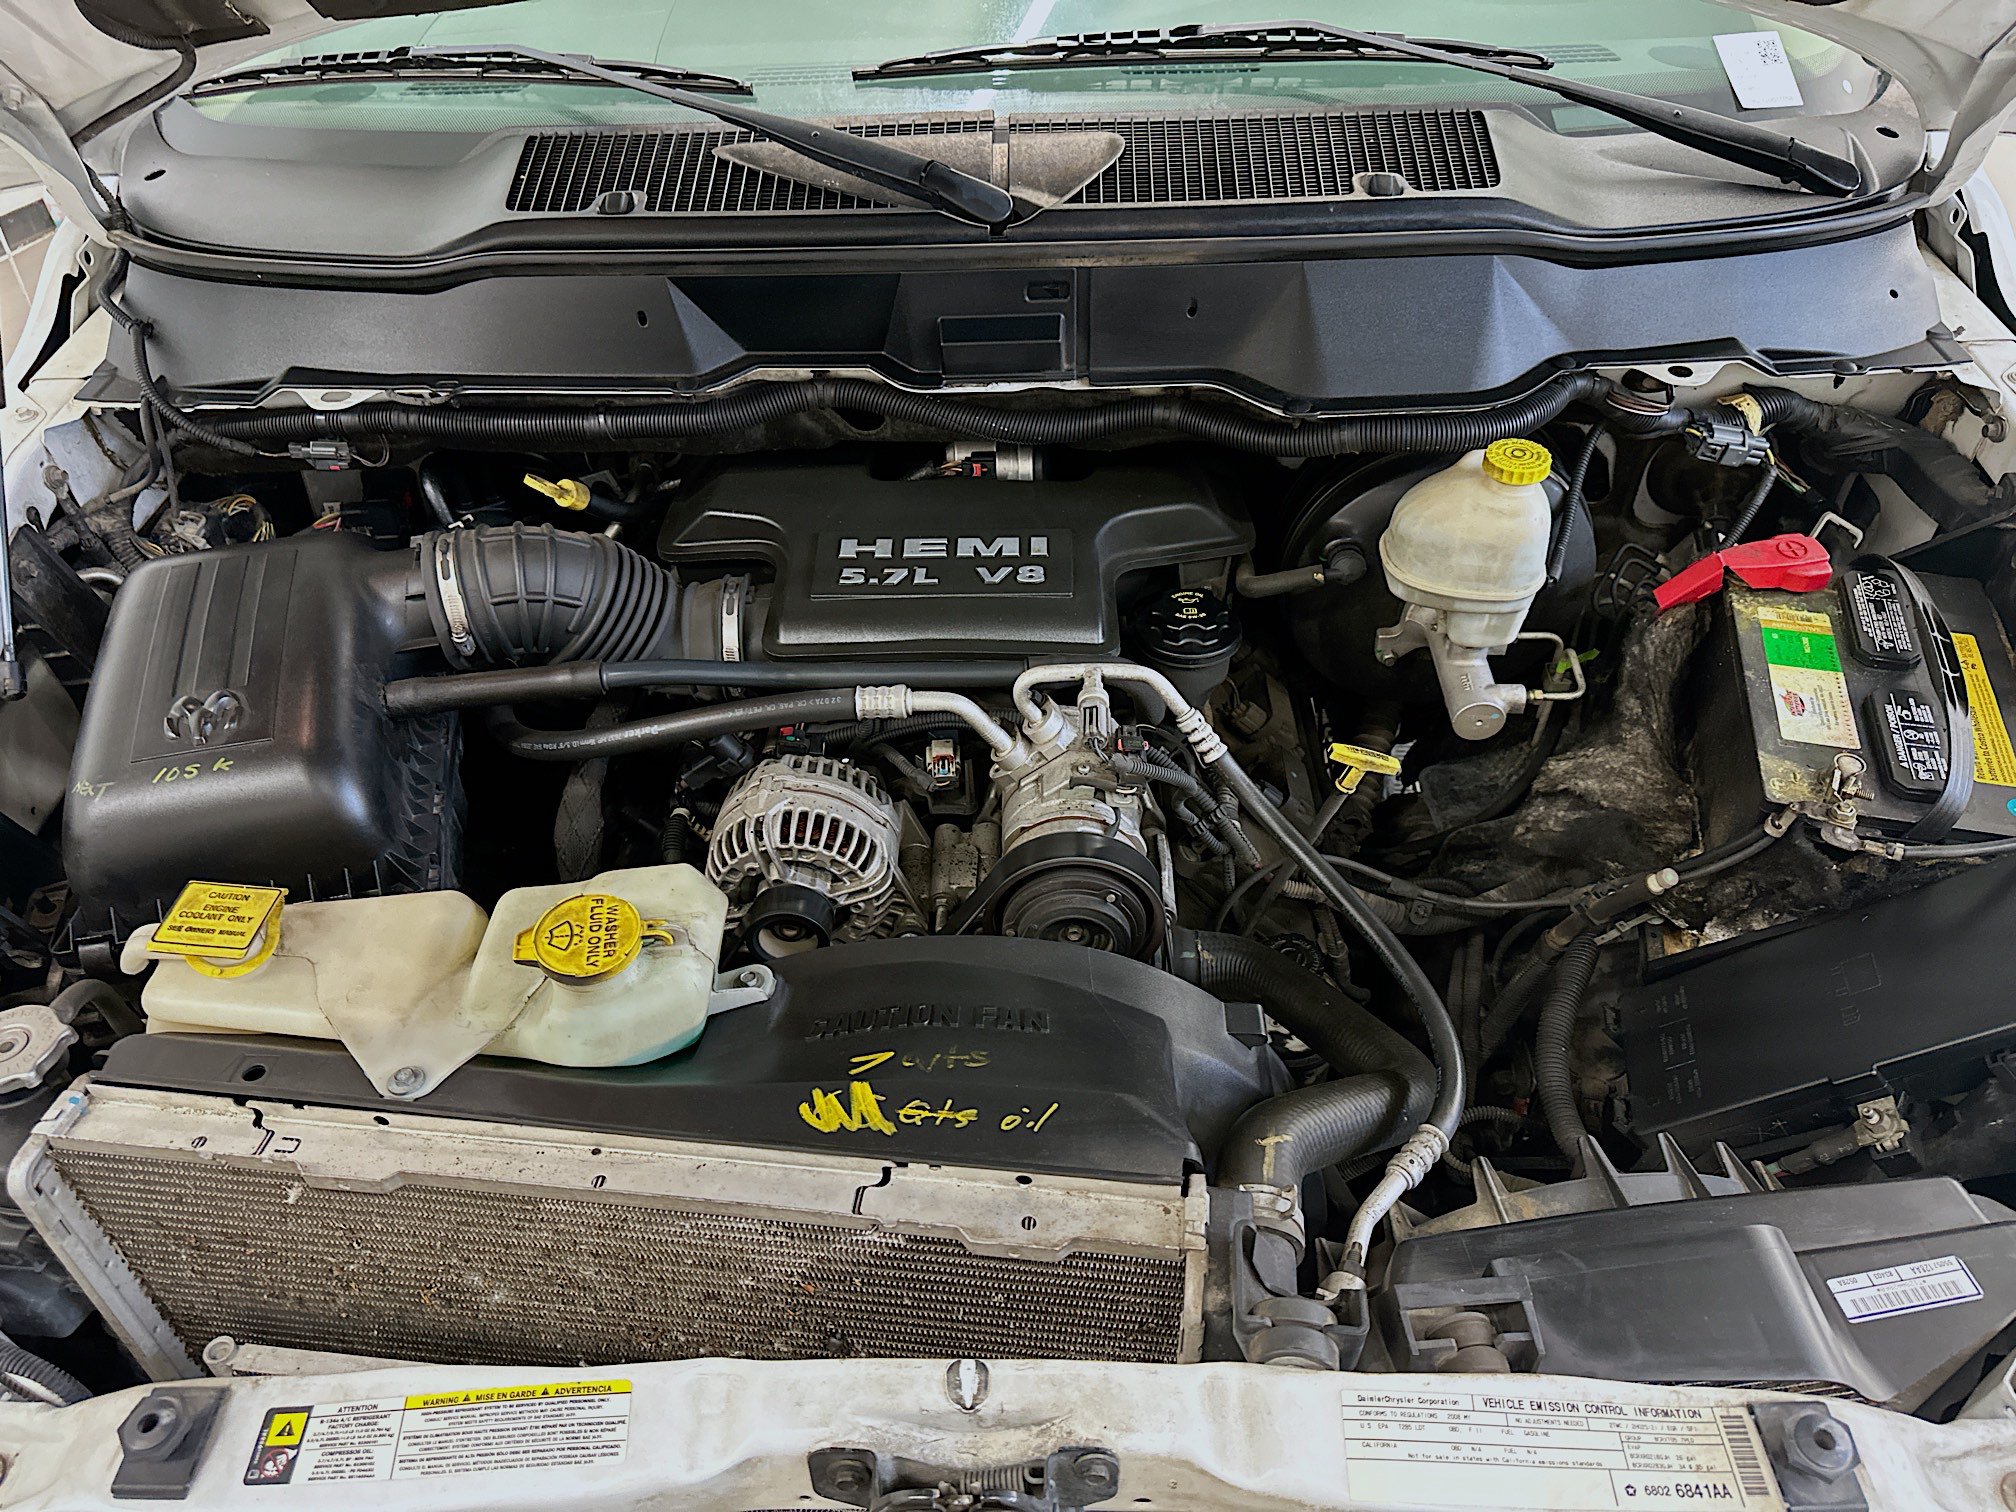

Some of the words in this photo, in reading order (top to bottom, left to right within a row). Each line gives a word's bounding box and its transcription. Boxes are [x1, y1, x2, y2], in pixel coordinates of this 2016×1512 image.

[838, 537, 1049, 558] HEMI
[838, 567, 938, 585] 5.7L
[976, 566, 1045, 584] V8
[152, 764, 200, 784] 105
[209, 891, 251, 901] CAUTION
[179, 911, 225, 920] COOLANT
[227, 915, 254, 923] ONLY
[203, 904, 240, 913] ENGINE
[587, 898, 604, 933] FLUID
[602, 904, 620, 958] WASHER
[586, 936, 602, 968] ONLY
[804, 1004, 960, 1040] CAUTION
[975, 1006, 1050, 1034] FAN
[423, 1396, 459, 1406] WARNING
[476, 1393, 494, 1401] MISE
[509, 1390, 537, 1398] GARDE
[554, 1385, 612, 1395] ADVERTENCIA
[1357, 1394, 1414, 1404] DaimlerChrysler
[1418, 1397, 1459, 1406] Corporation
[337, 1404, 379, 1413] ATTENTION
[1482, 1397, 1525, 1410] VEHICLE
[1530, 1401, 1580, 1413] EMISSION
[1585, 1403, 1628, 1416] CONTROL
[1634, 1407, 1702, 1419] INFORMATION
[1645, 1485, 1671, 1496] 6802
[1675, 1483, 1733, 1499] 6841AA
